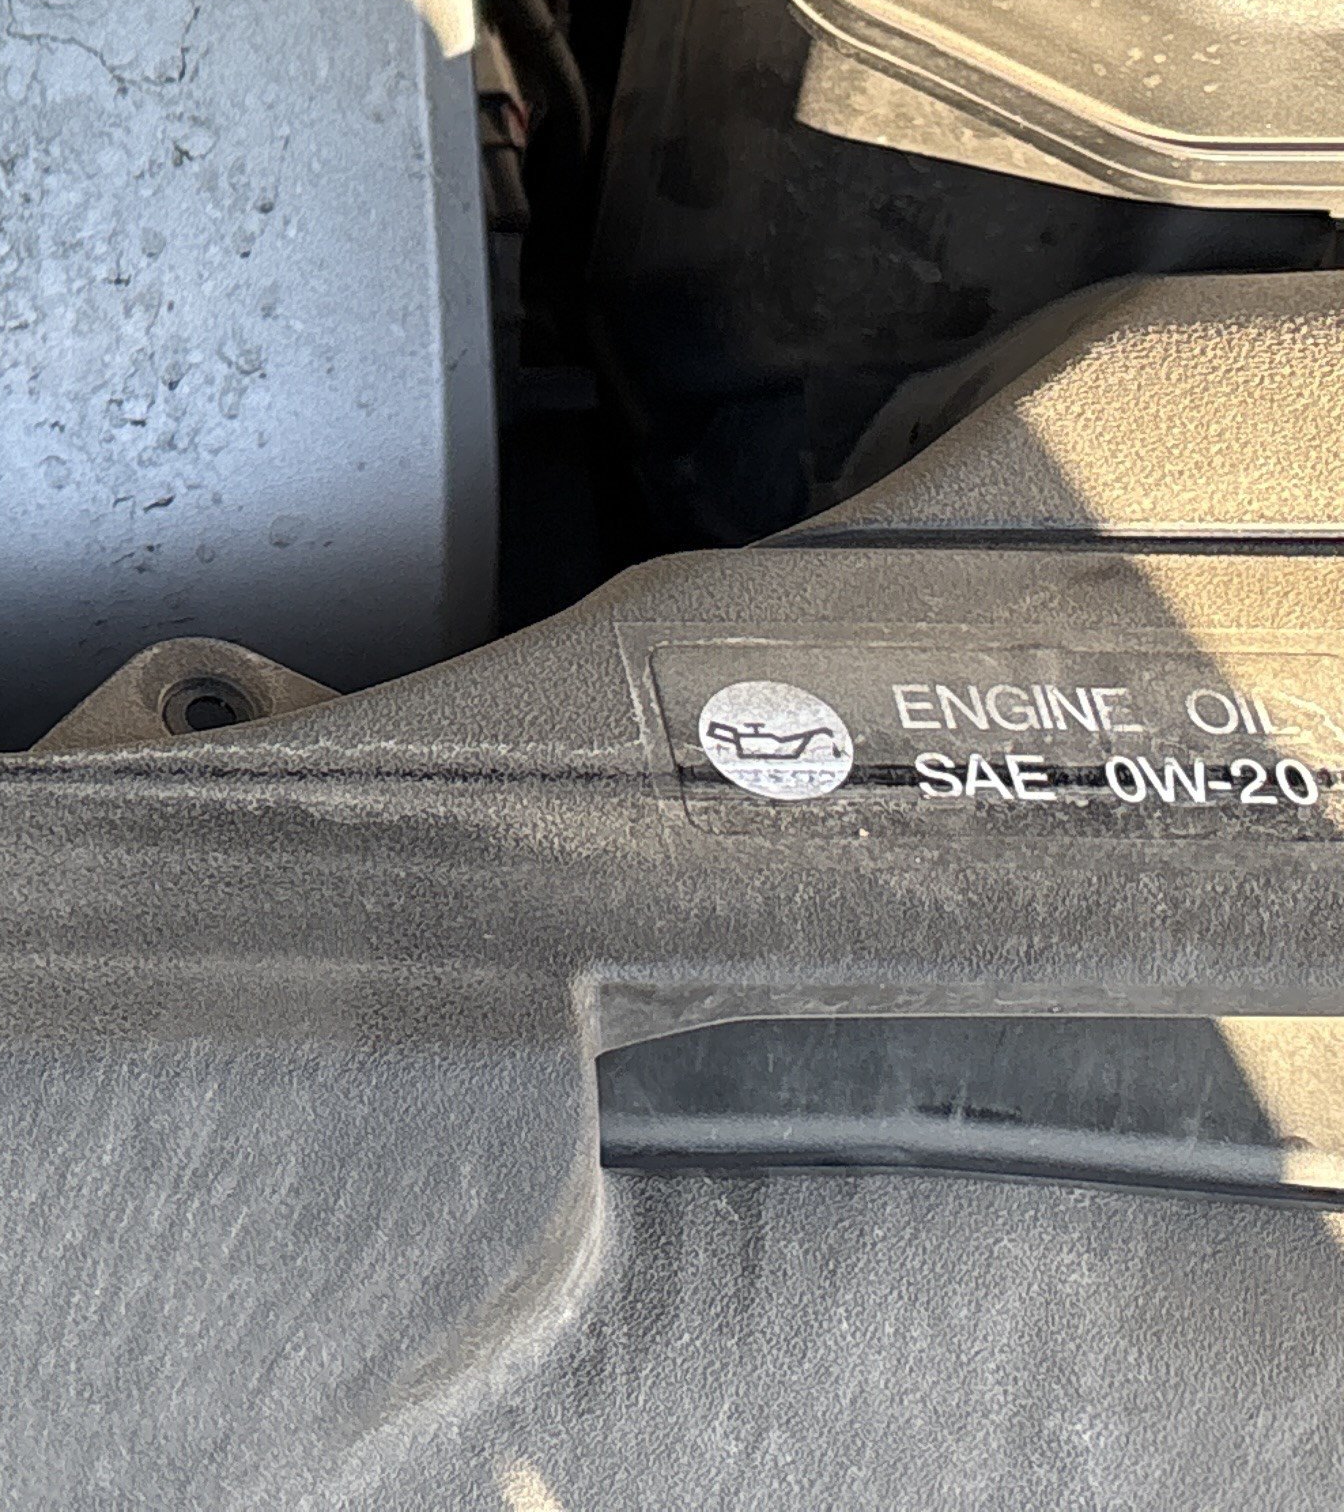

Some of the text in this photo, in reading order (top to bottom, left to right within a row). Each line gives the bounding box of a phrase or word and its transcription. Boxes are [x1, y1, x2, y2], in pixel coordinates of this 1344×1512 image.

[891, 683, 1302, 735] ENGINE OIL
[914, 751, 1320, 806] SAE 0W-20
